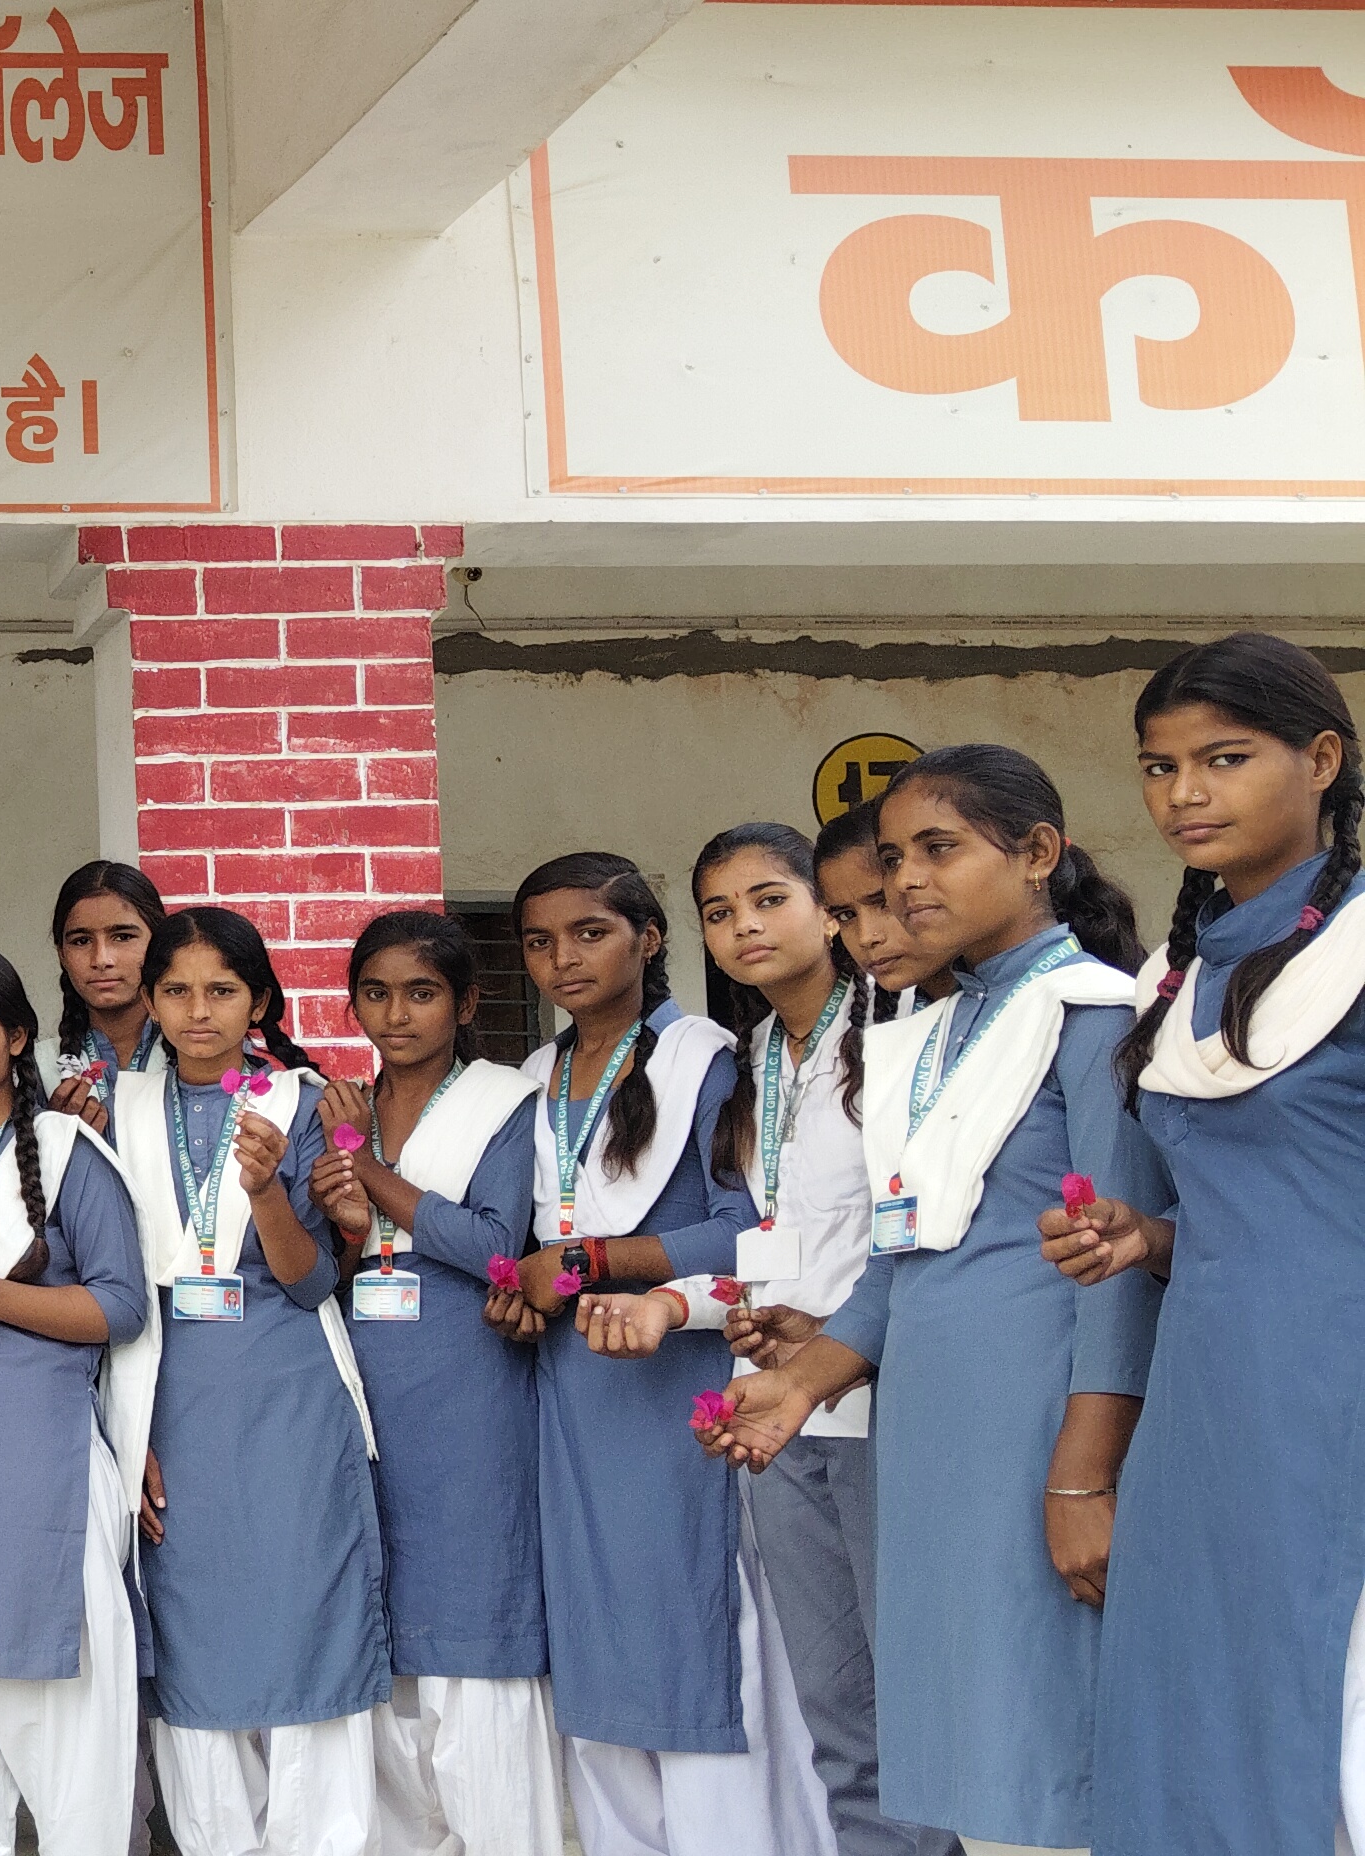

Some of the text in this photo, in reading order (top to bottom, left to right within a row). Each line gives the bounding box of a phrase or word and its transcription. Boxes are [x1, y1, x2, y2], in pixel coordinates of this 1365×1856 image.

[807, 988, 845, 1049] KAILA DEVI
[909, 1111, 928, 1137] ABA
[1038, 947, 1070, 971] DEVI
[768, 1056, 779, 1083] A.I.C.
[572, 1121, 592, 1155] RATAN
[587, 1096, 603, 1118] GIRI
[612, 1037, 634, 1065] KAILA
[765, 1086, 777, 1109] GIRI
[558, 1123, 568, 1156] RATAN
[764, 1111, 775, 1150] RATAN
[179, 1150, 190, 1171] GIRI
[216, 1146, 228, 1167] GIRI
[184, 1172, 198, 1205] RATAN
[208, 1169, 221, 1203] RATAN
[205, 1204, 216, 1234] BABA
